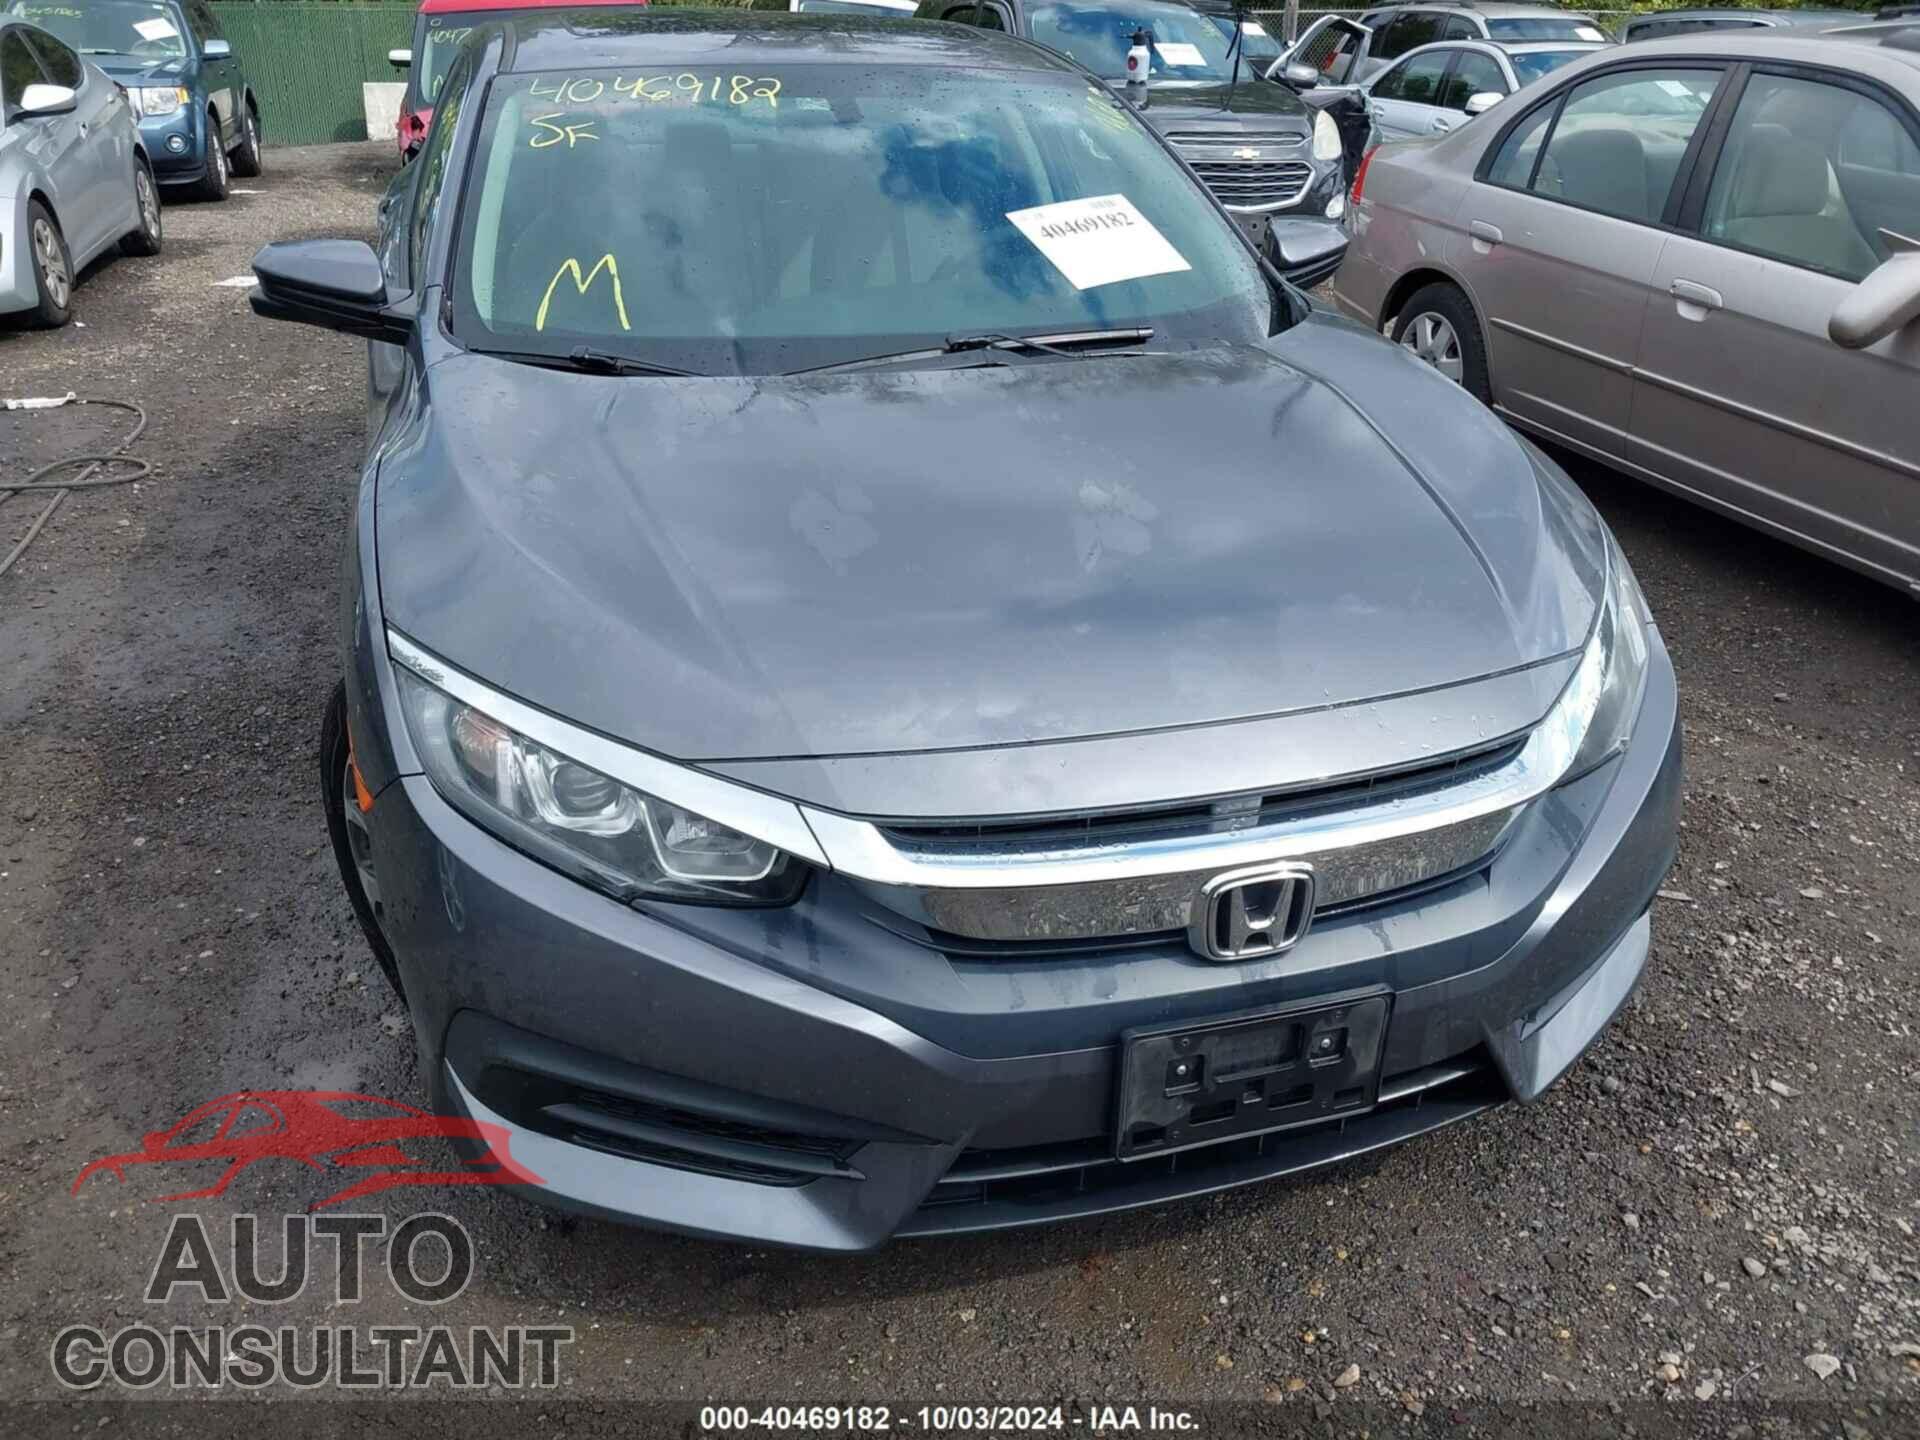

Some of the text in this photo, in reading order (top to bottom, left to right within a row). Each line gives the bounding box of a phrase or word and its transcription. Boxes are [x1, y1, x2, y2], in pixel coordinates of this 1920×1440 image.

[529, 73, 781, 107] 40469182
[1040, 211, 1135, 239] 40469182
[536, 253, 631, 331] M
